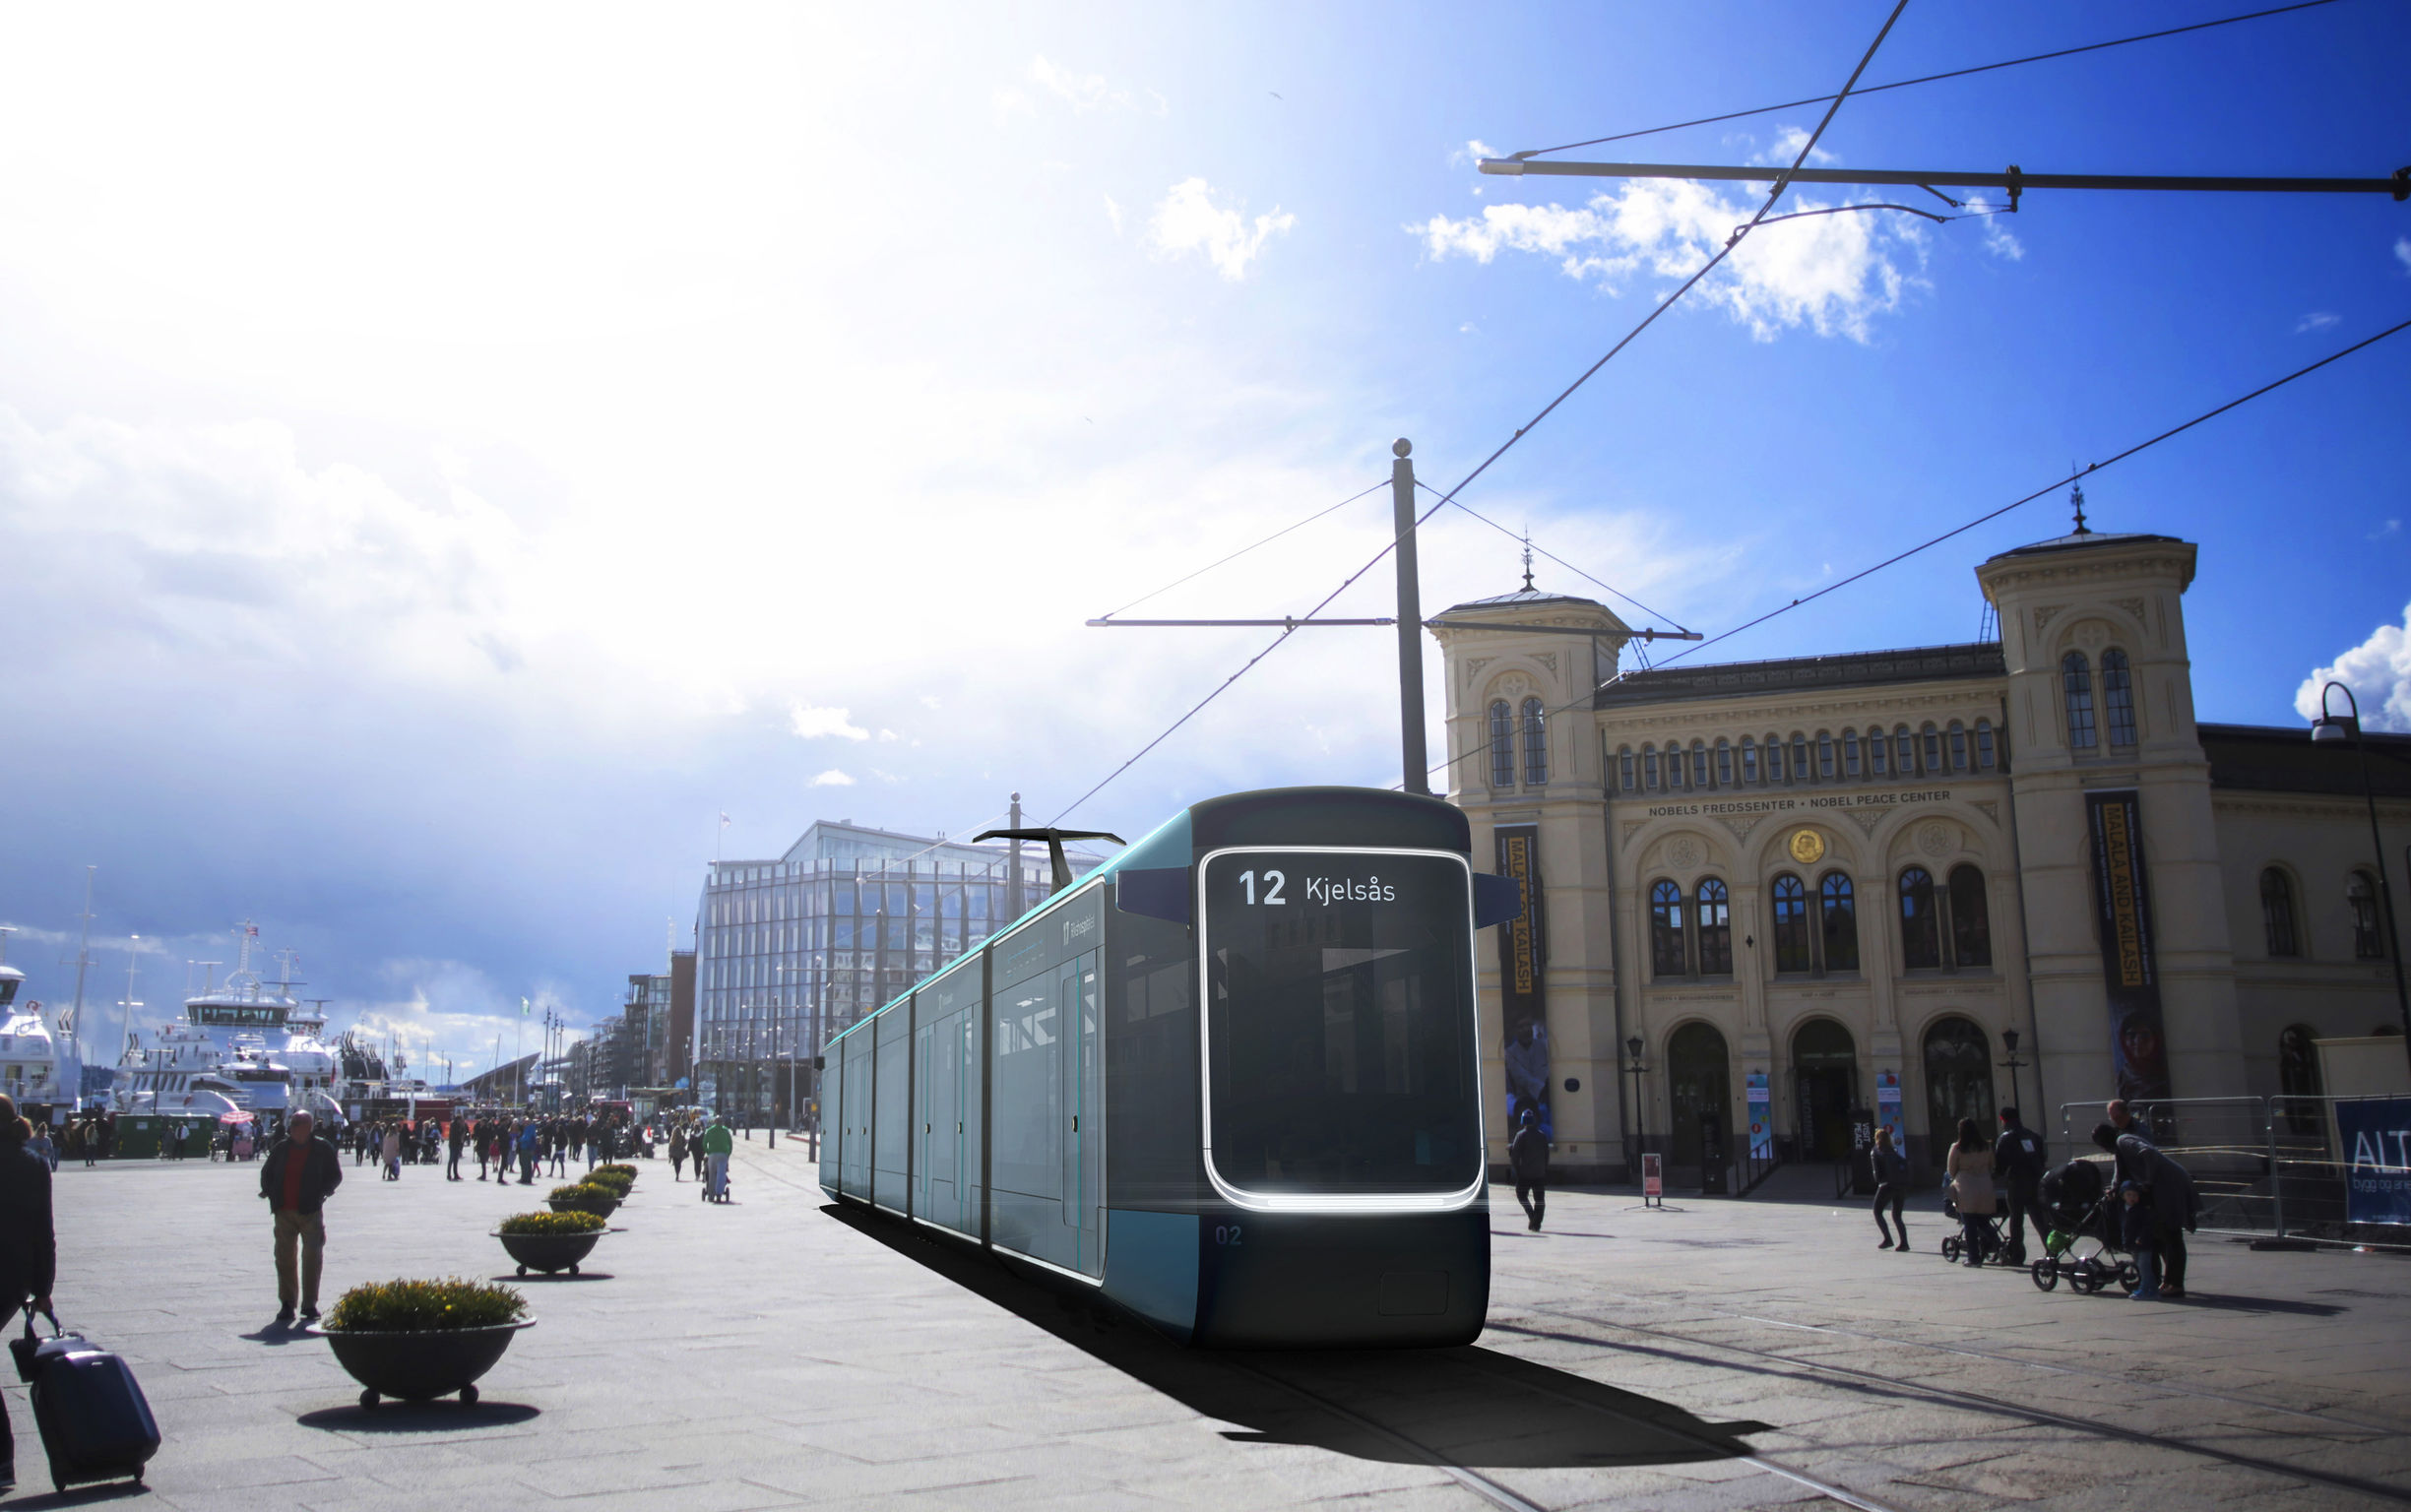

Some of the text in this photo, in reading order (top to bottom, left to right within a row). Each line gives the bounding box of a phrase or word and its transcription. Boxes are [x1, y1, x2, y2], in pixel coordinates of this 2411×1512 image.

[1649, 790, 1951, 817] NOBELS FREDSSENTER NOBEL PEACE CENTER
[1238, 869, 1396, 907] 12 Kjelsås
[2107, 807, 2138, 983] MALALA AND KAILASH
[1516, 928, 1529, 990] KAILASH
[1855, 1122, 1864, 1150] PEACE
[2353, 1176, 2378, 1193] bygg
[2379, 1179, 2392, 1193] og
[1216, 1226, 1241, 1245] 02
